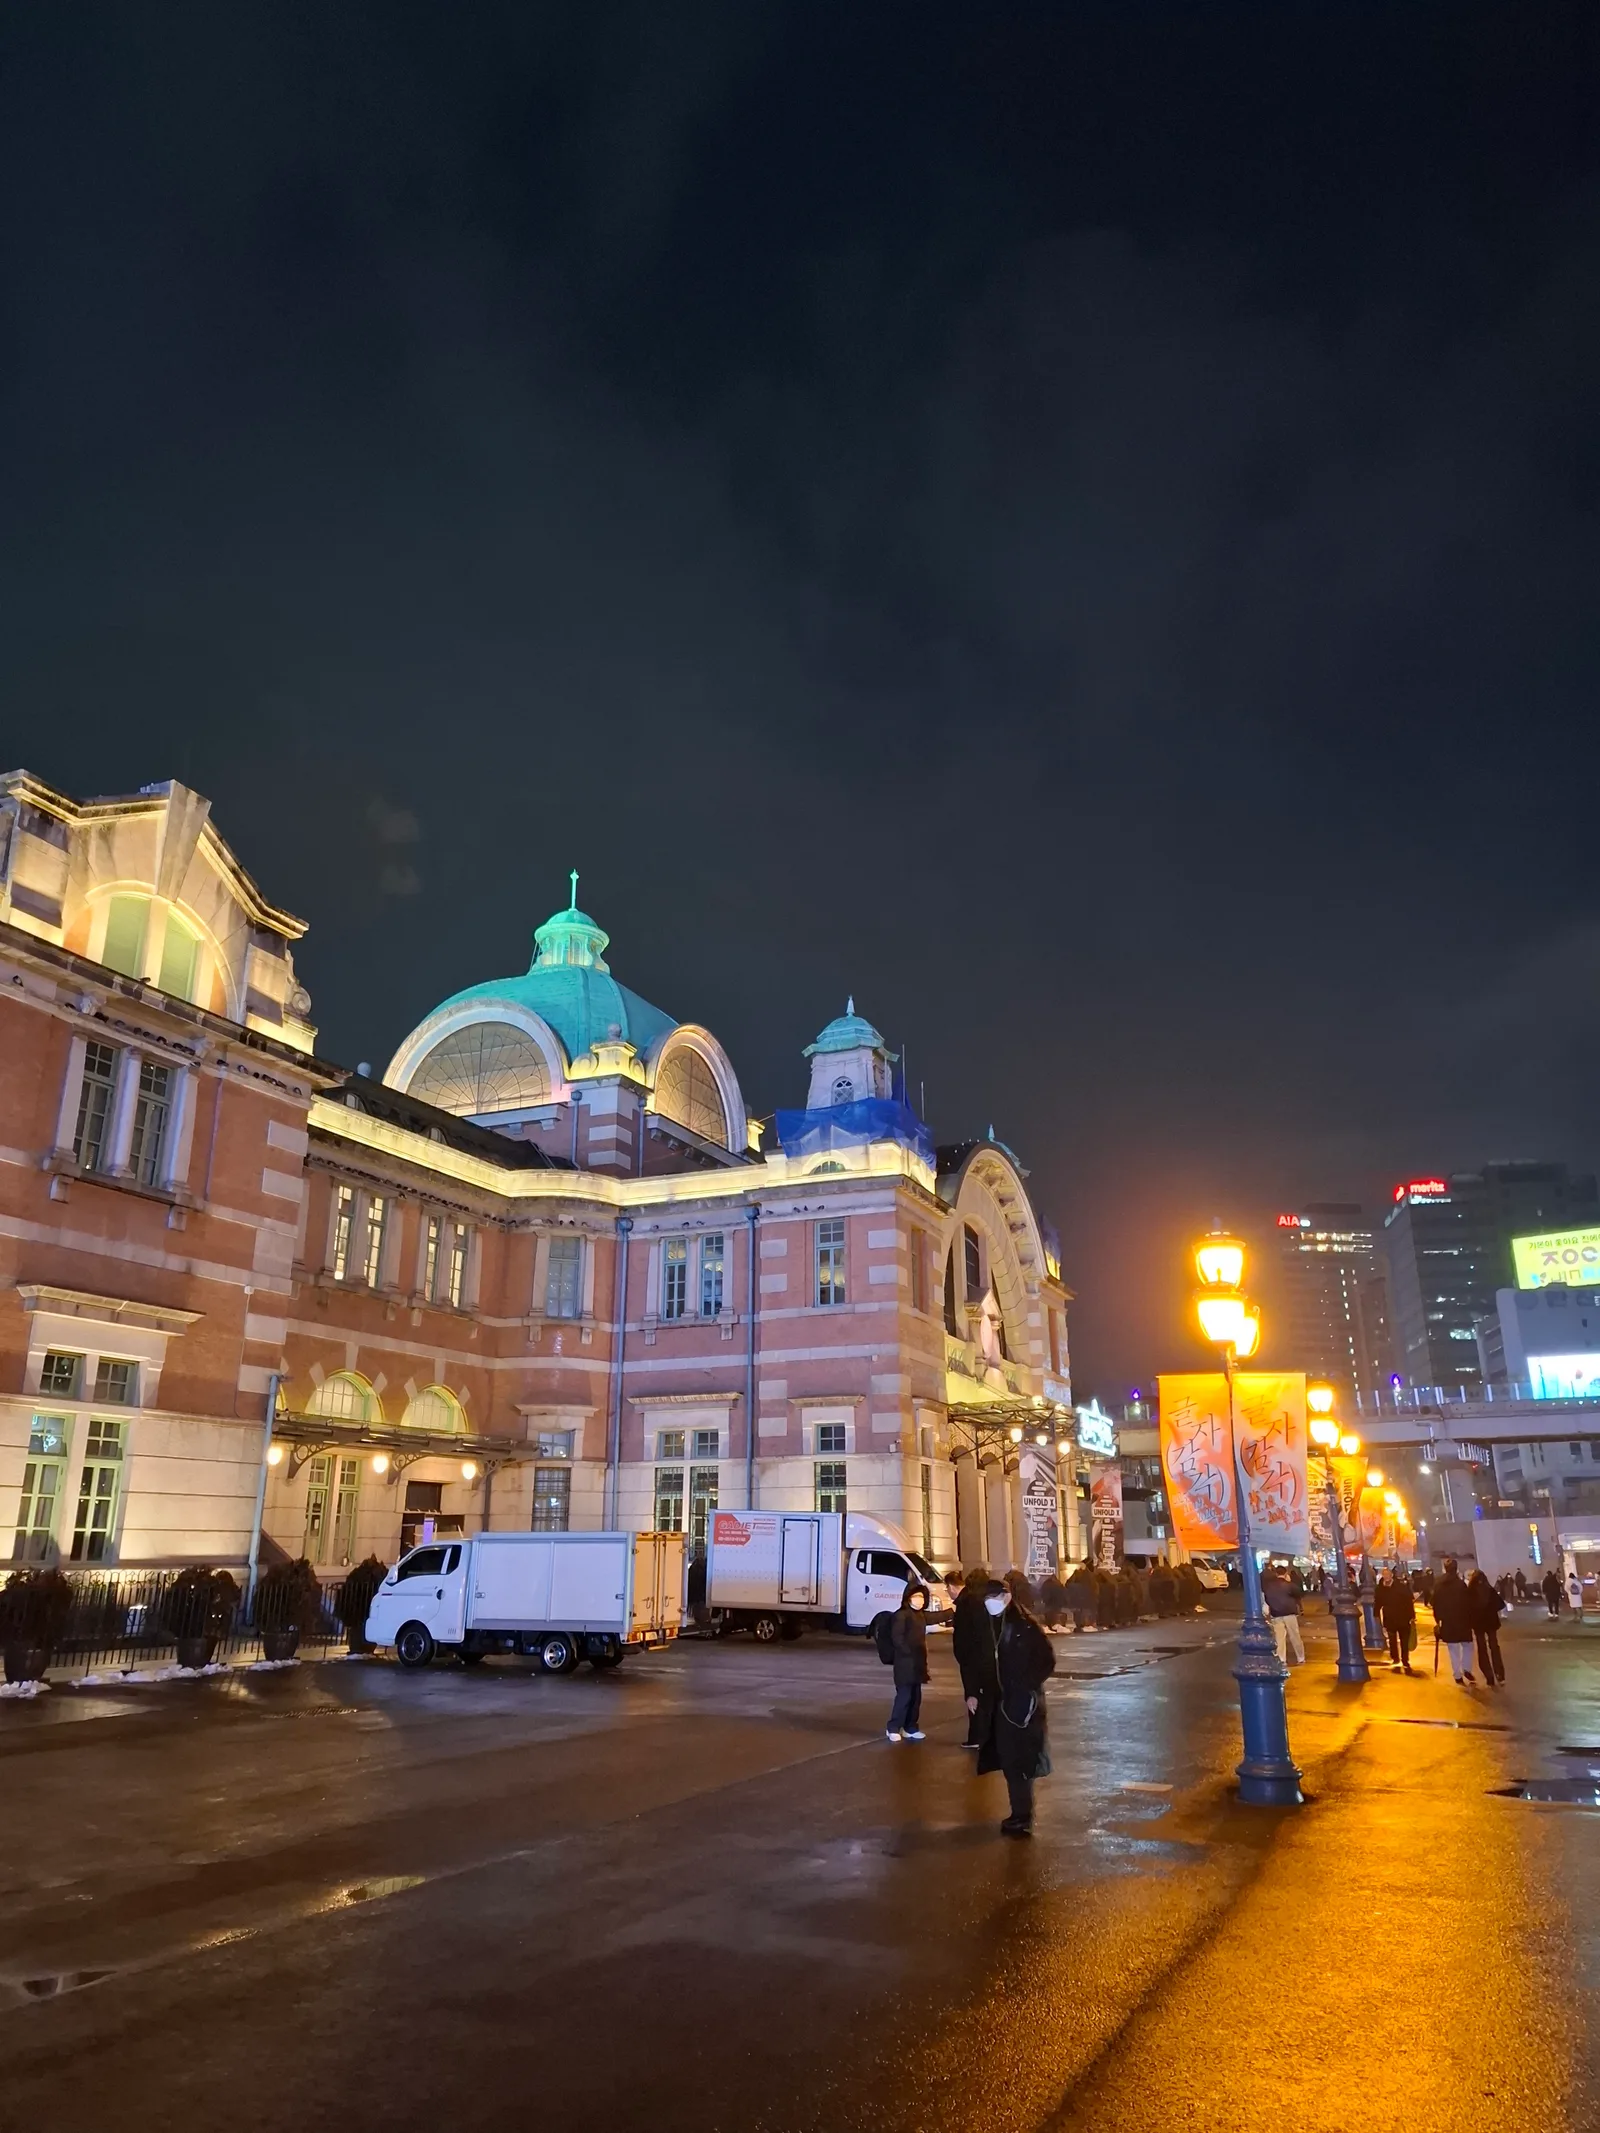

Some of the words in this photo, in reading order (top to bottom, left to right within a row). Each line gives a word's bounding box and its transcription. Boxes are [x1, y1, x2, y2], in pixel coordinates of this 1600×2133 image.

[1409, 1181, 1445, 1192] meritz
[1278, 1216, 1300, 1226] AIA
[1167, 1395, 1222, 1447] 글자
[1241, 1394, 1297, 1446] 글자
[1023, 1497, 1049, 1506] UNFOLD
[1050, 1499, 1055, 1507] X
